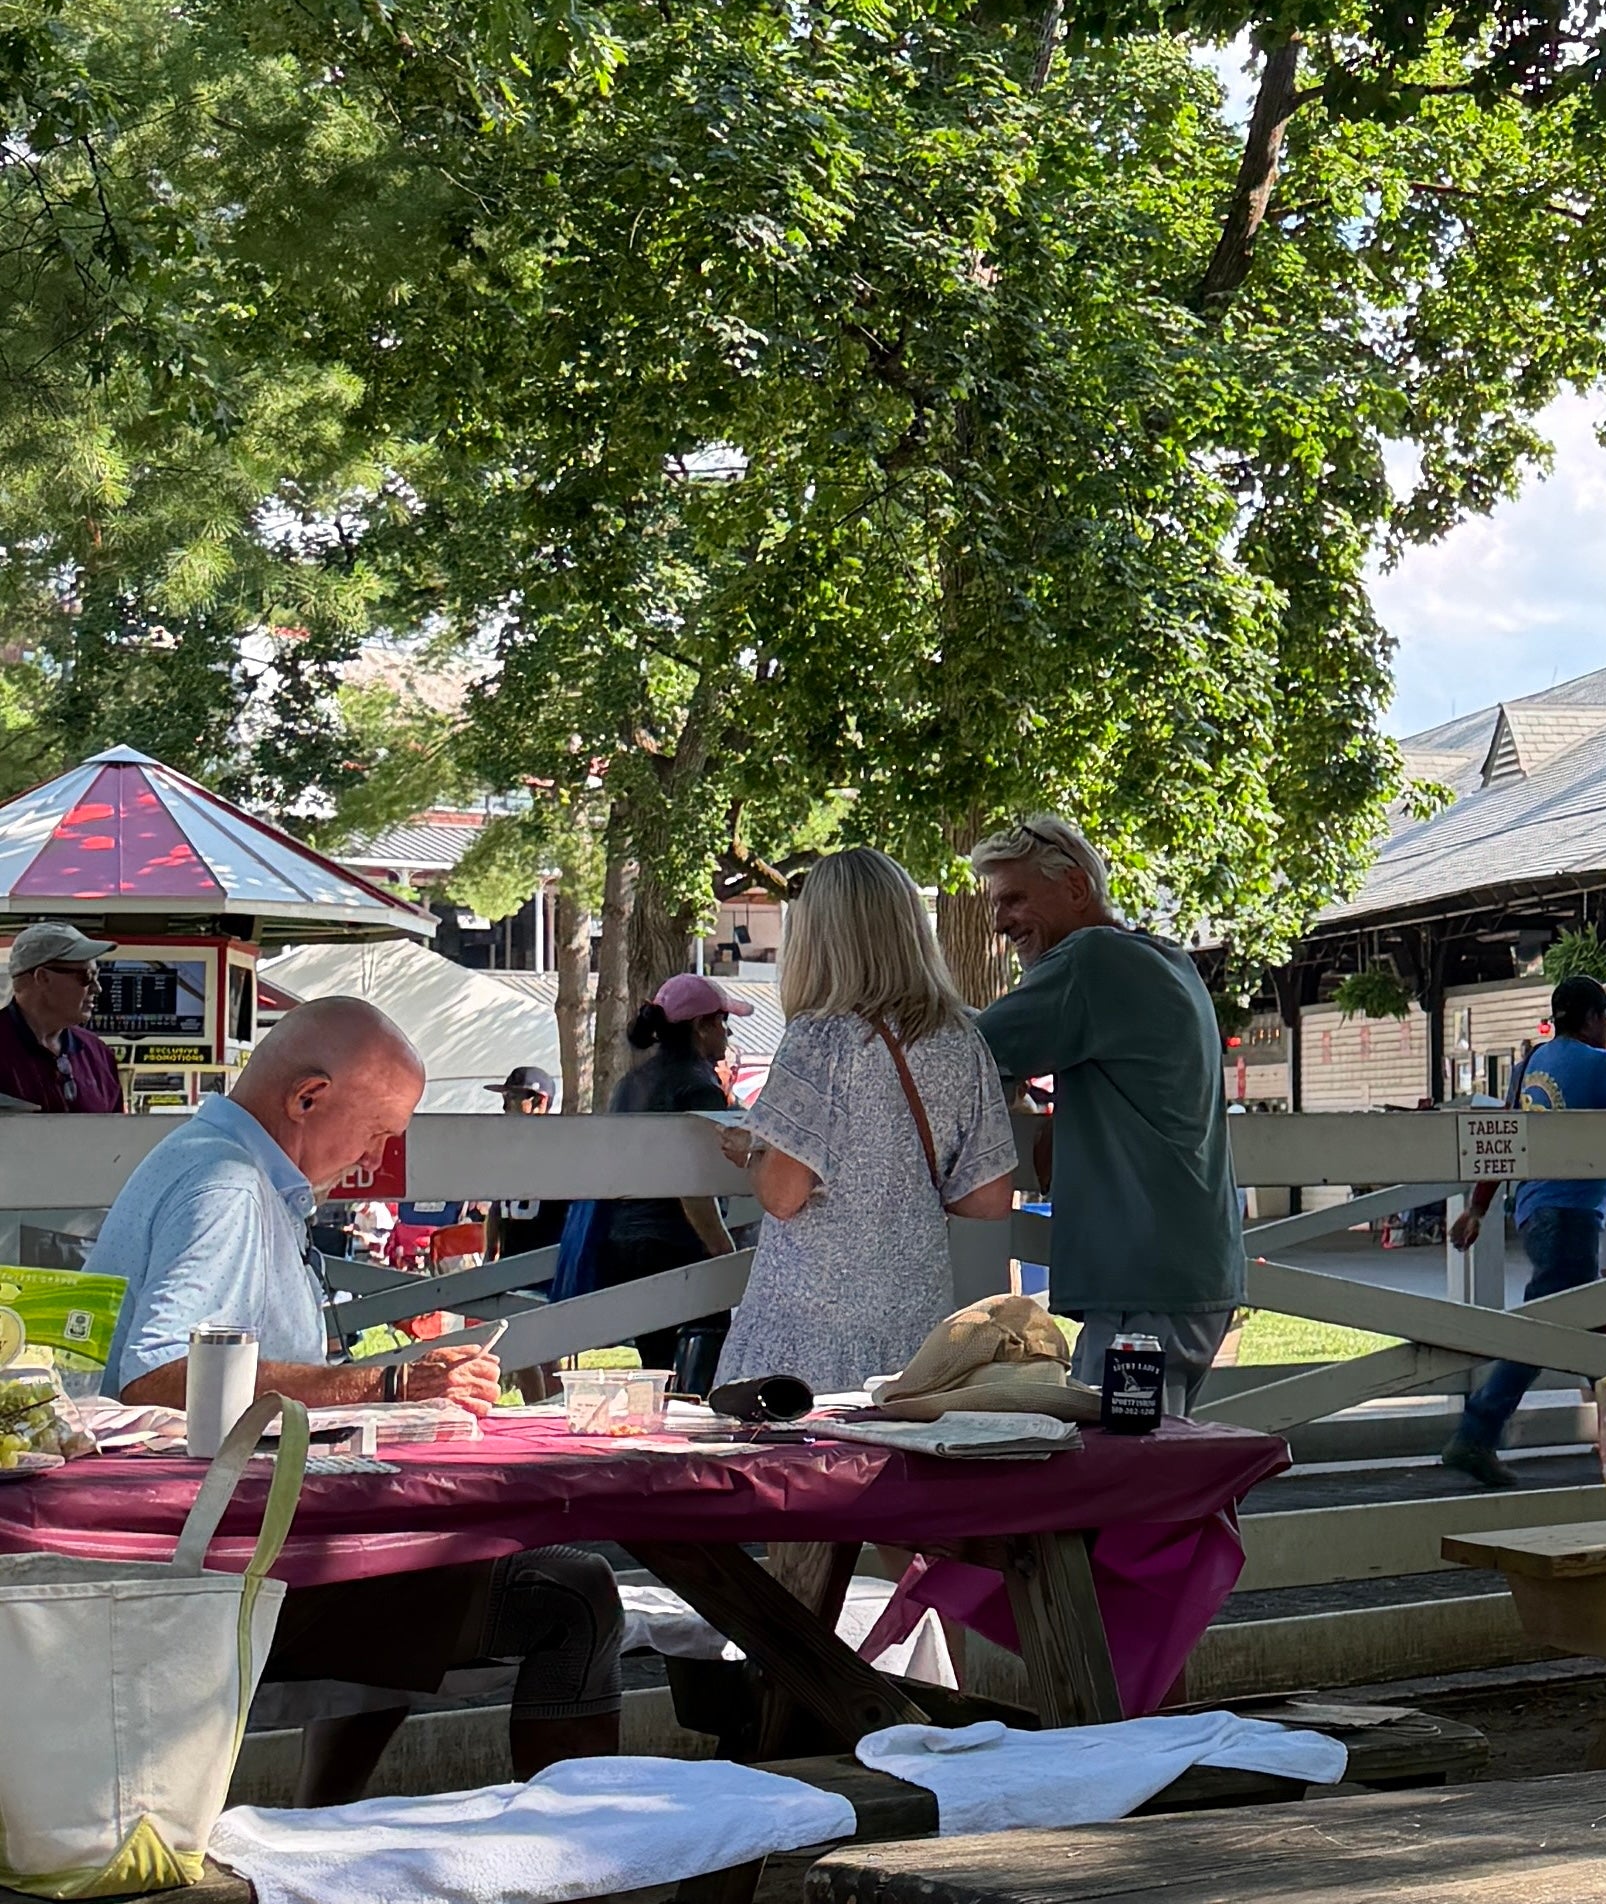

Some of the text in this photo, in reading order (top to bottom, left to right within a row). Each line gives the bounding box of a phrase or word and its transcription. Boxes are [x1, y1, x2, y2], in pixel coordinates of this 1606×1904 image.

[1467, 1120, 1518, 1135] TABLES
[1475, 1139, 1512, 1154] BACK
[1484, 1158, 1516, 1174] FEET
